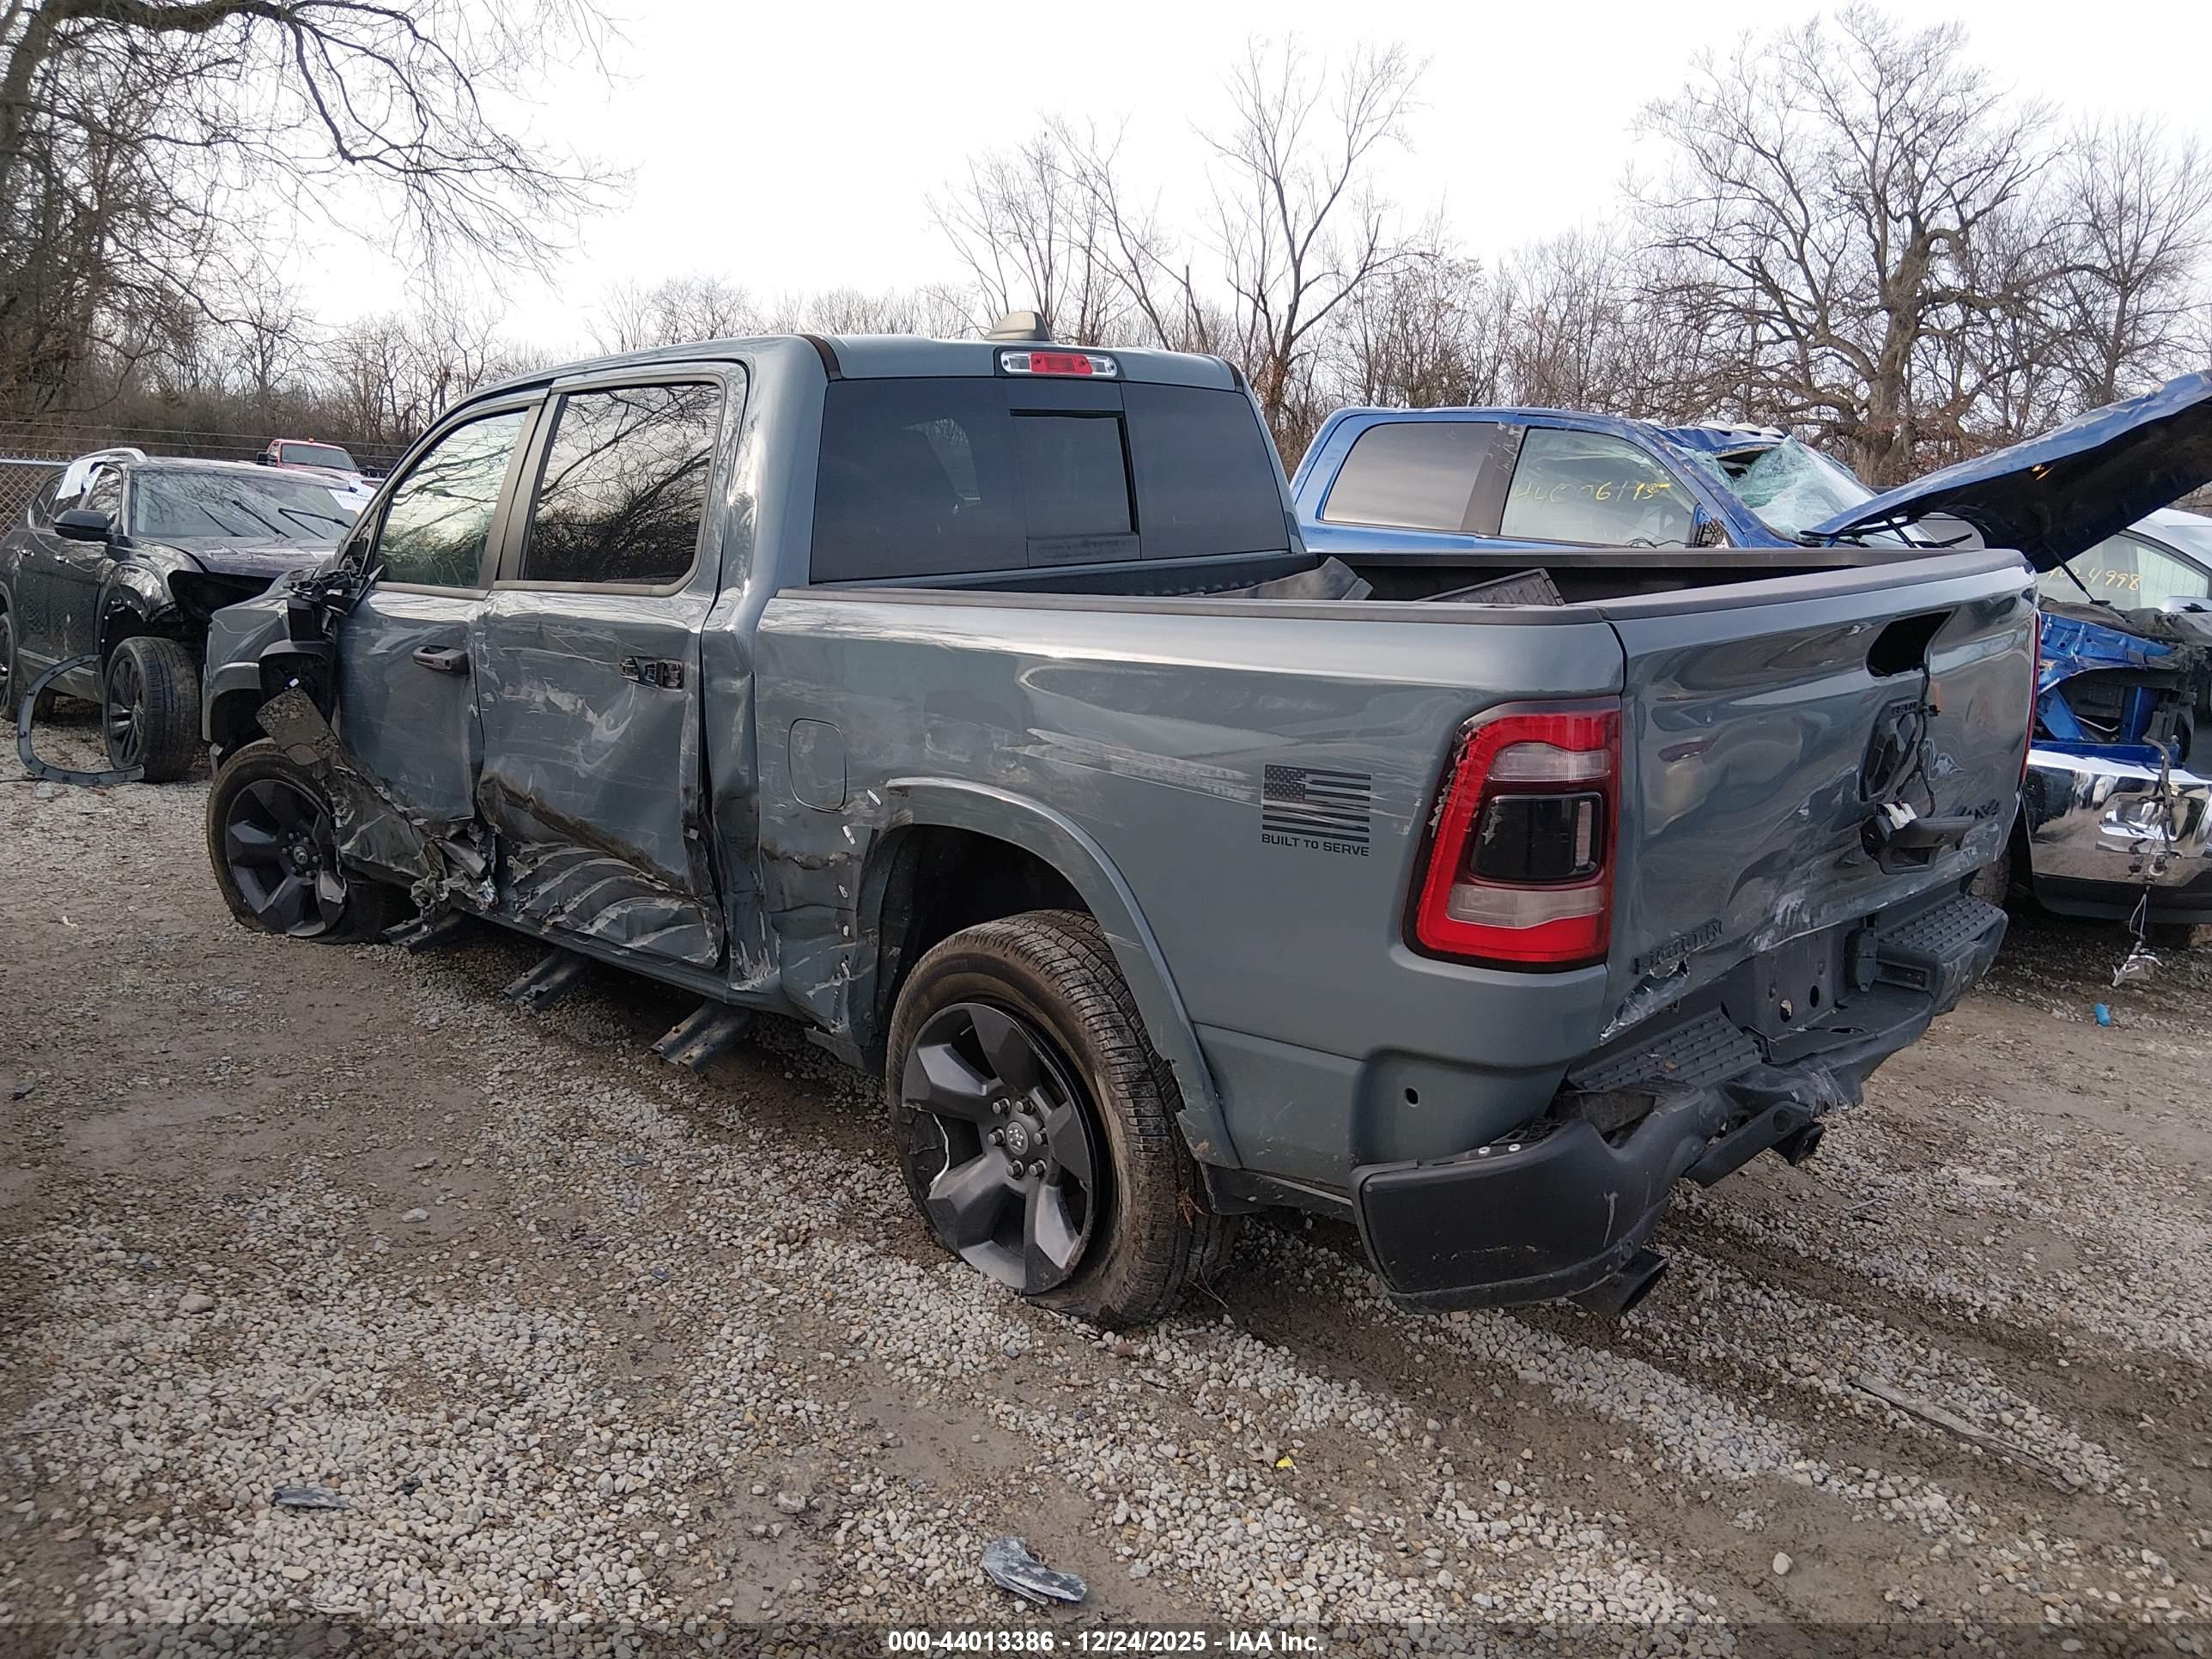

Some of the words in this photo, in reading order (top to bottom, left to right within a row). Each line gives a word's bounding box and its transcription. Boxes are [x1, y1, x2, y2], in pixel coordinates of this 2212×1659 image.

[1261, 833, 1300, 848] BUILT
[1304, 839, 1319, 849] TO
[1322, 841, 1370, 857] SERVE
